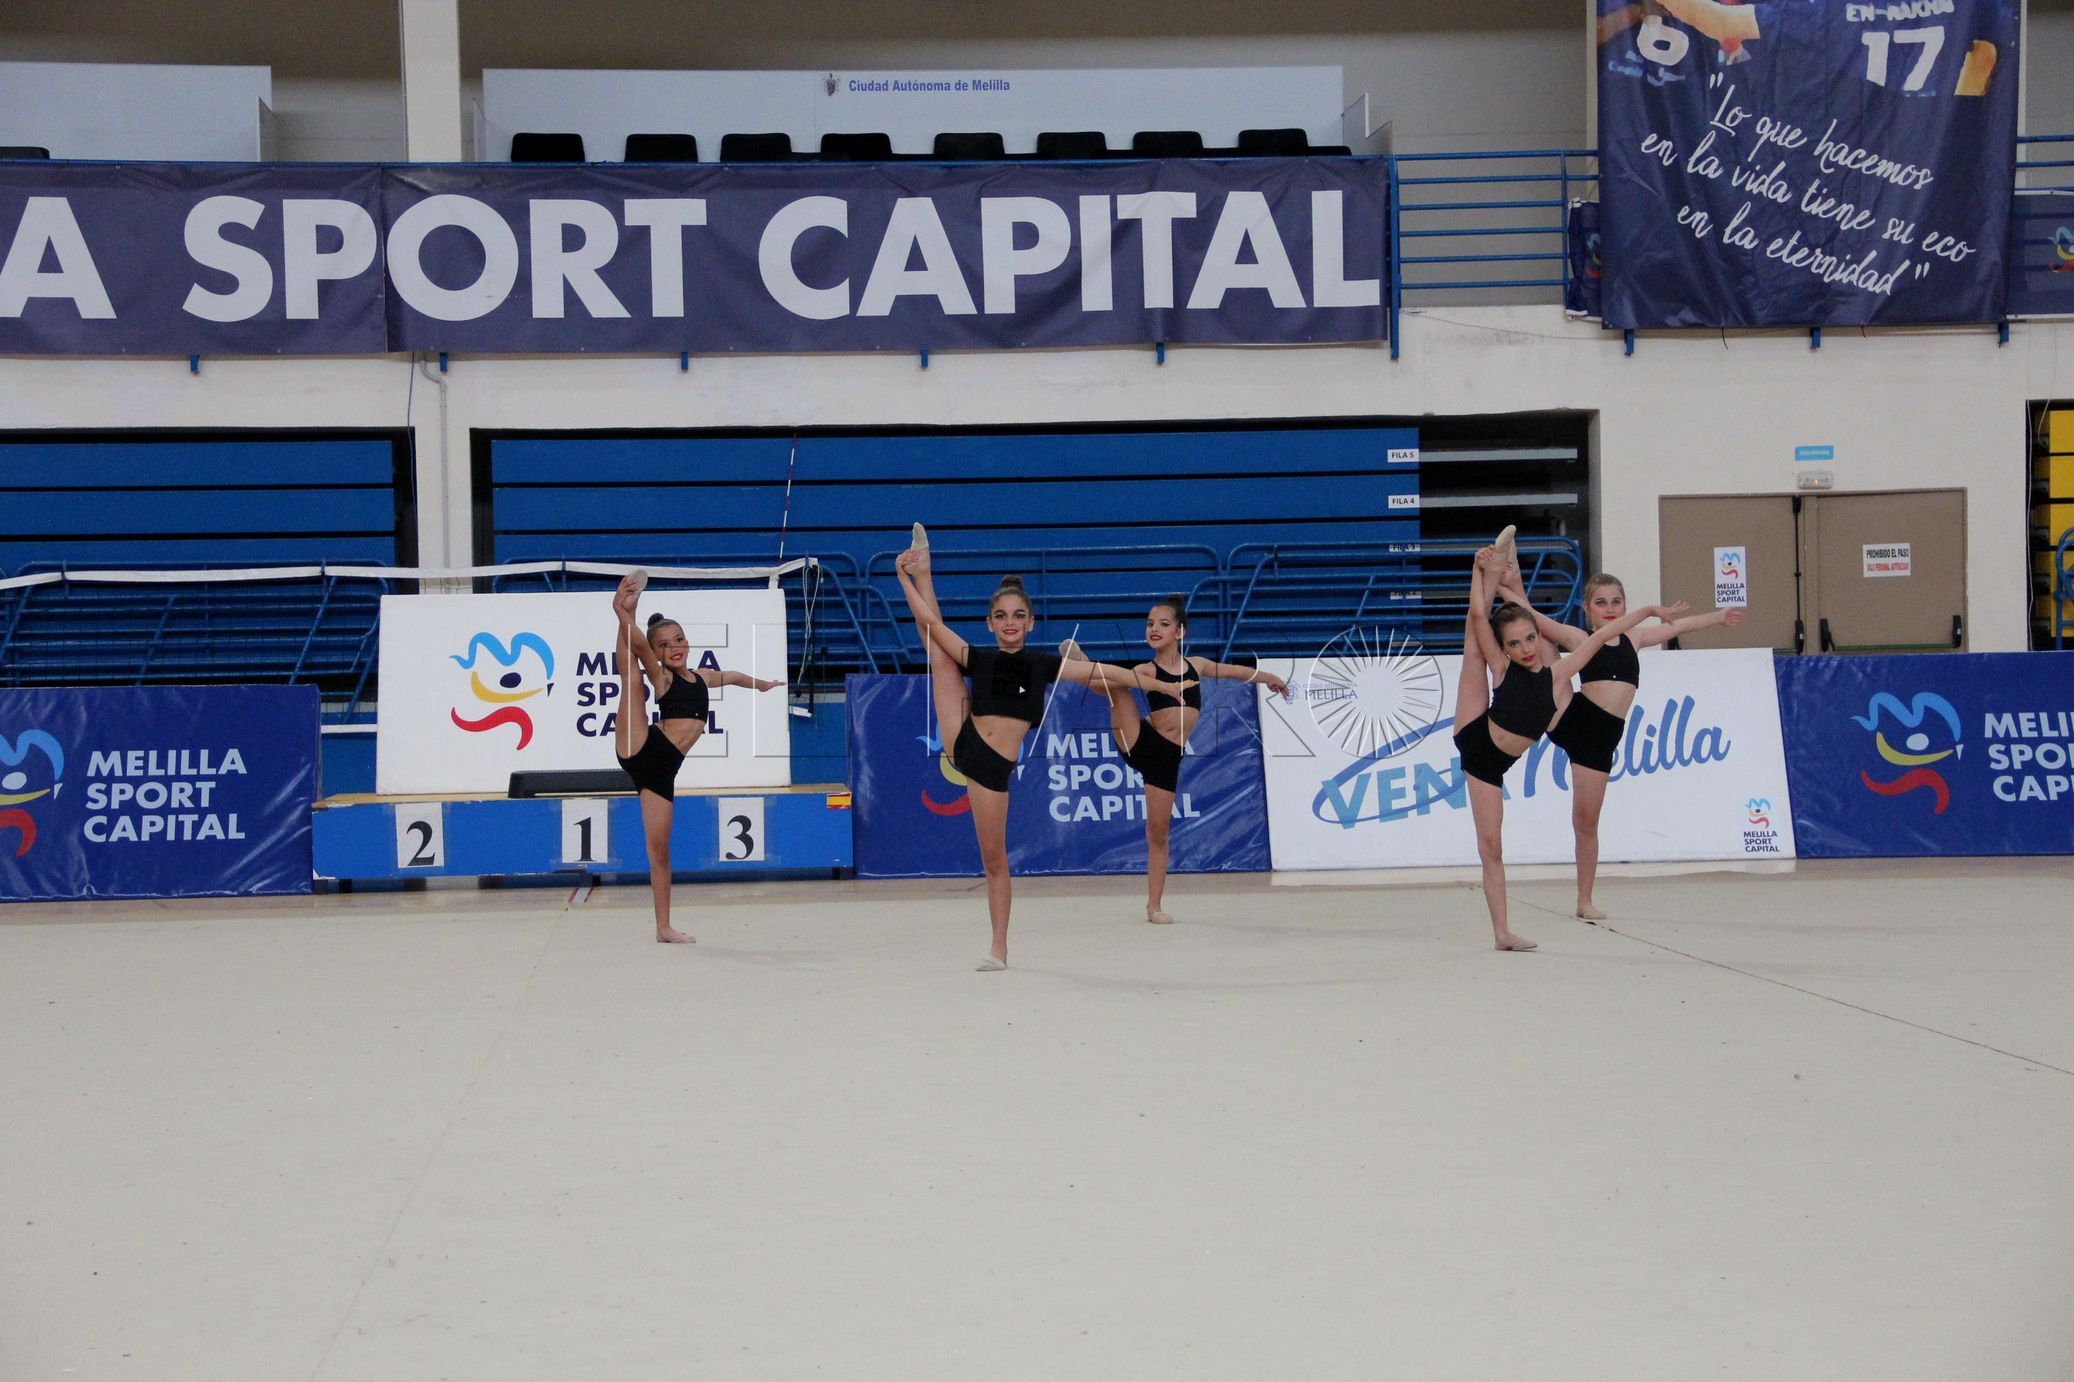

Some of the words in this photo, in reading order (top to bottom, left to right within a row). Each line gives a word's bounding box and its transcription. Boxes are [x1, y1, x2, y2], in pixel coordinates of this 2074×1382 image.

[1637, 15, 1689, 67] 6
[1862, 26, 1945, 91] 17
[849, 80, 889, 92] Ciudad
[892, 79, 951, 92] Autónoma
[954, 80, 968, 92] de
[972, 79, 1010, 91] Melilla
[1748, 117, 1807, 161] que
[1814, 119, 1934, 190] hacemos
[1641, 133, 1678, 166] en
[1687, 130, 1723, 178] la
[1731, 160, 1793, 203] vida
[1800, 178, 1875, 230] tiene
[1882, 218, 1915, 244] su
[1922, 231, 1976, 262] eco
[1677, 205, 1713, 238] en
[1723, 201, 1759, 249] la
[182, 194, 707, 322] SPORT
[758, 190, 1380, 320] CAPITAL
[1391, 451, 1408, 459] FILA
[1410, 451, 1414, 459] 5
[1392, 497, 1408, 505] FILA
[1410, 497, 1415, 505] 4
[1984, 712, 2074, 738] MELI
[87, 749, 247, 777] MELILLA
[1988, 743, 2074, 770] SPO
[86, 781, 216, 810] SPORT
[1048, 763, 1144, 791] SPOR
[84, 813, 246, 842] CAPITAL
[406, 821, 436, 866] 2
[573, 816, 597, 862] 1
[725, 815, 754, 860] 3
